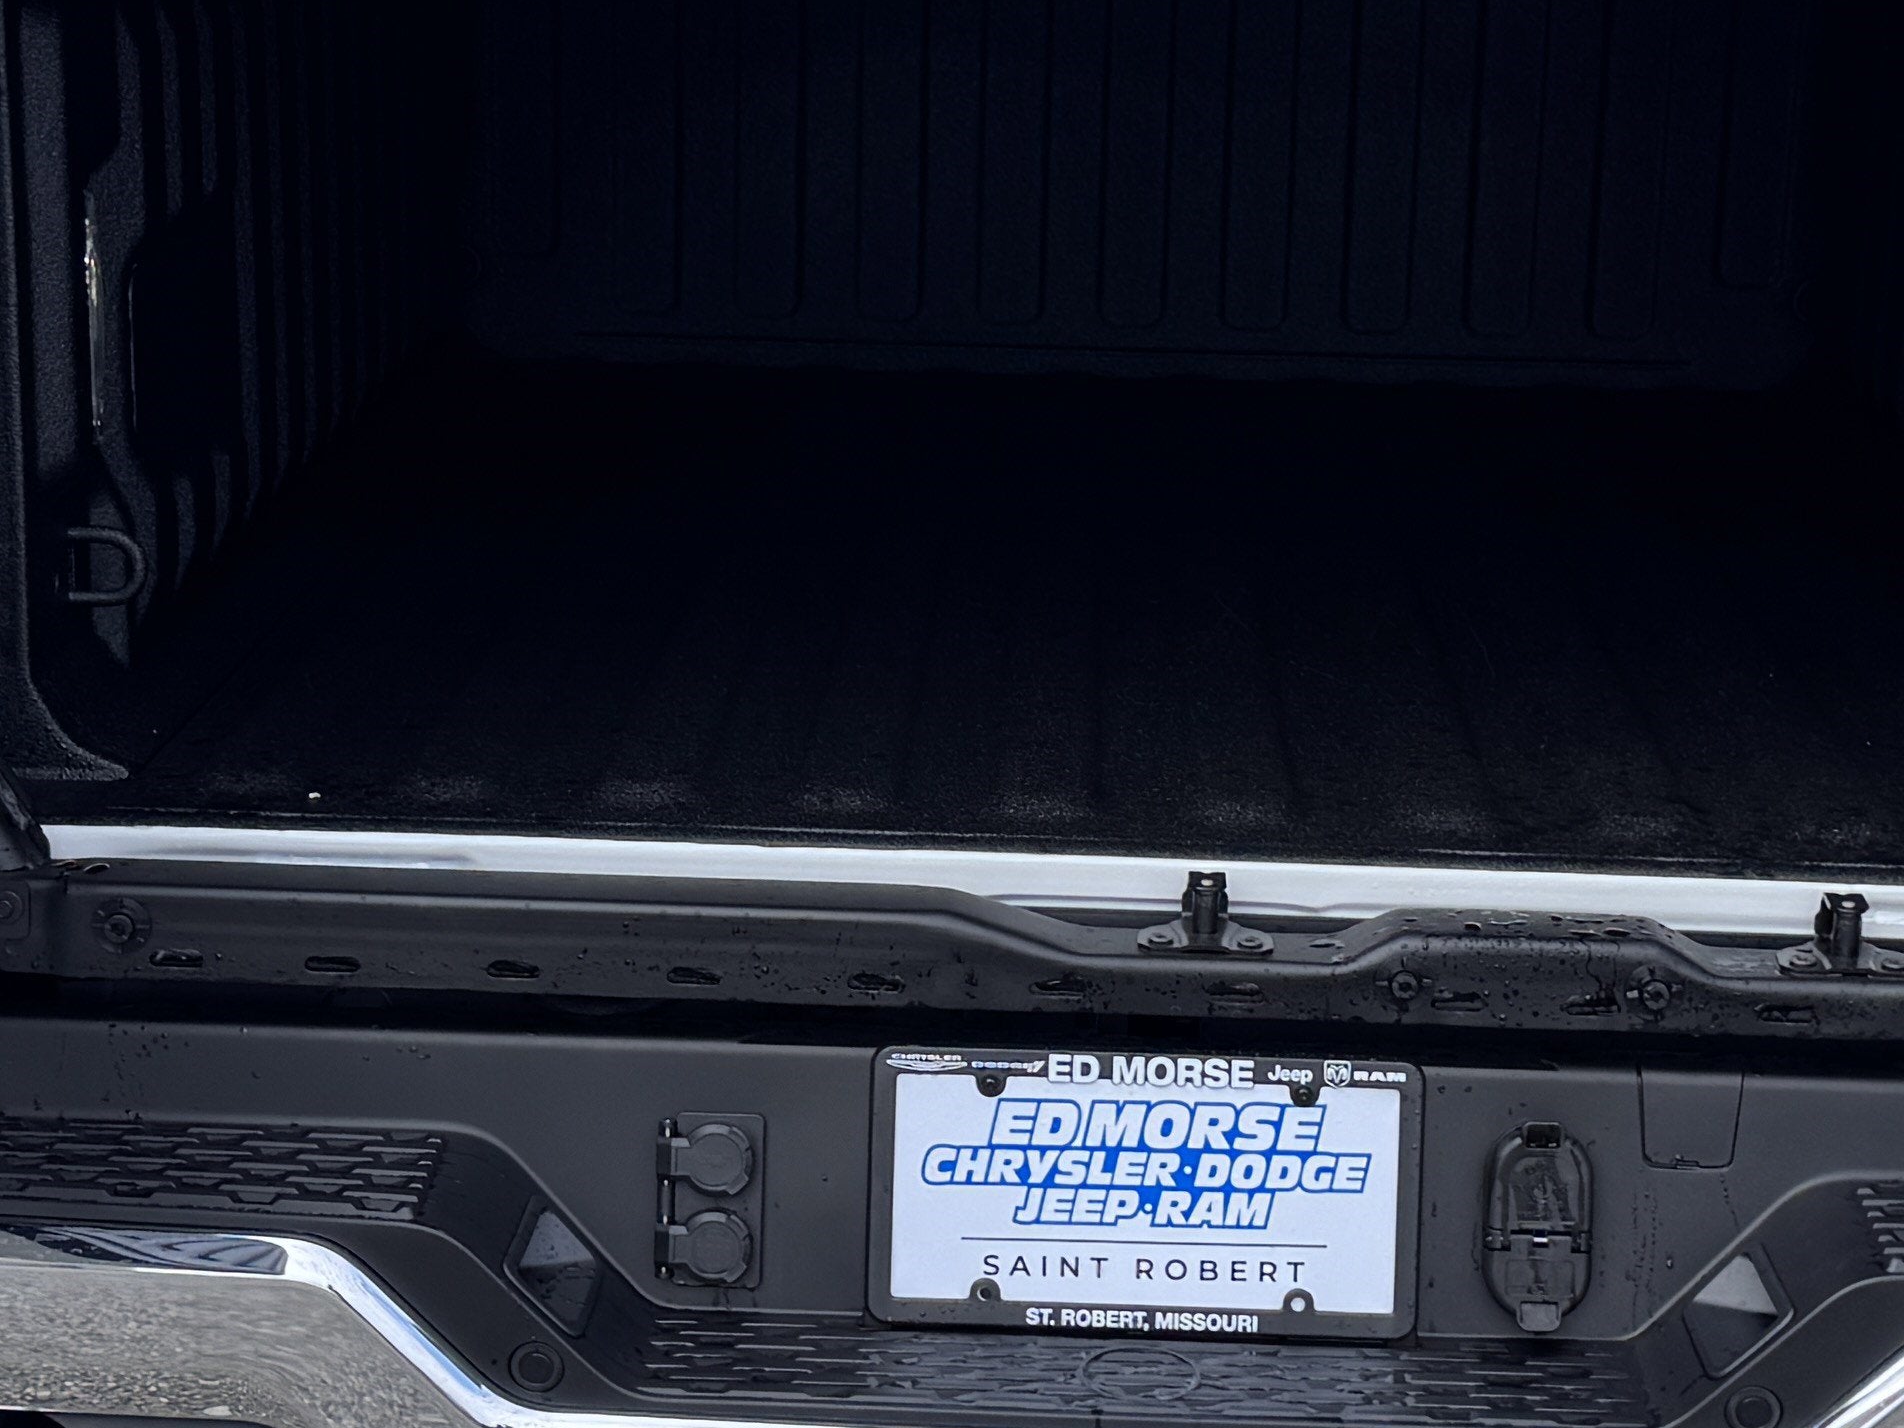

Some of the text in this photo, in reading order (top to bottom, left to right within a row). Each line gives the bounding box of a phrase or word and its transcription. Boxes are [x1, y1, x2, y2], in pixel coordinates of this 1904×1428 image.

[1048, 1053, 1255, 1088] ED MORSE
[1267, 1064, 1313, 1085] Jeep
[1353, 1070, 1407, 1083] RAM
[989, 1099, 1327, 1152] ED MORSE
[982, 1254, 1306, 1283] SAINT ROBERT
[1025, 1307, 1259, 1334] ST. ROBERT, MISSOURI
